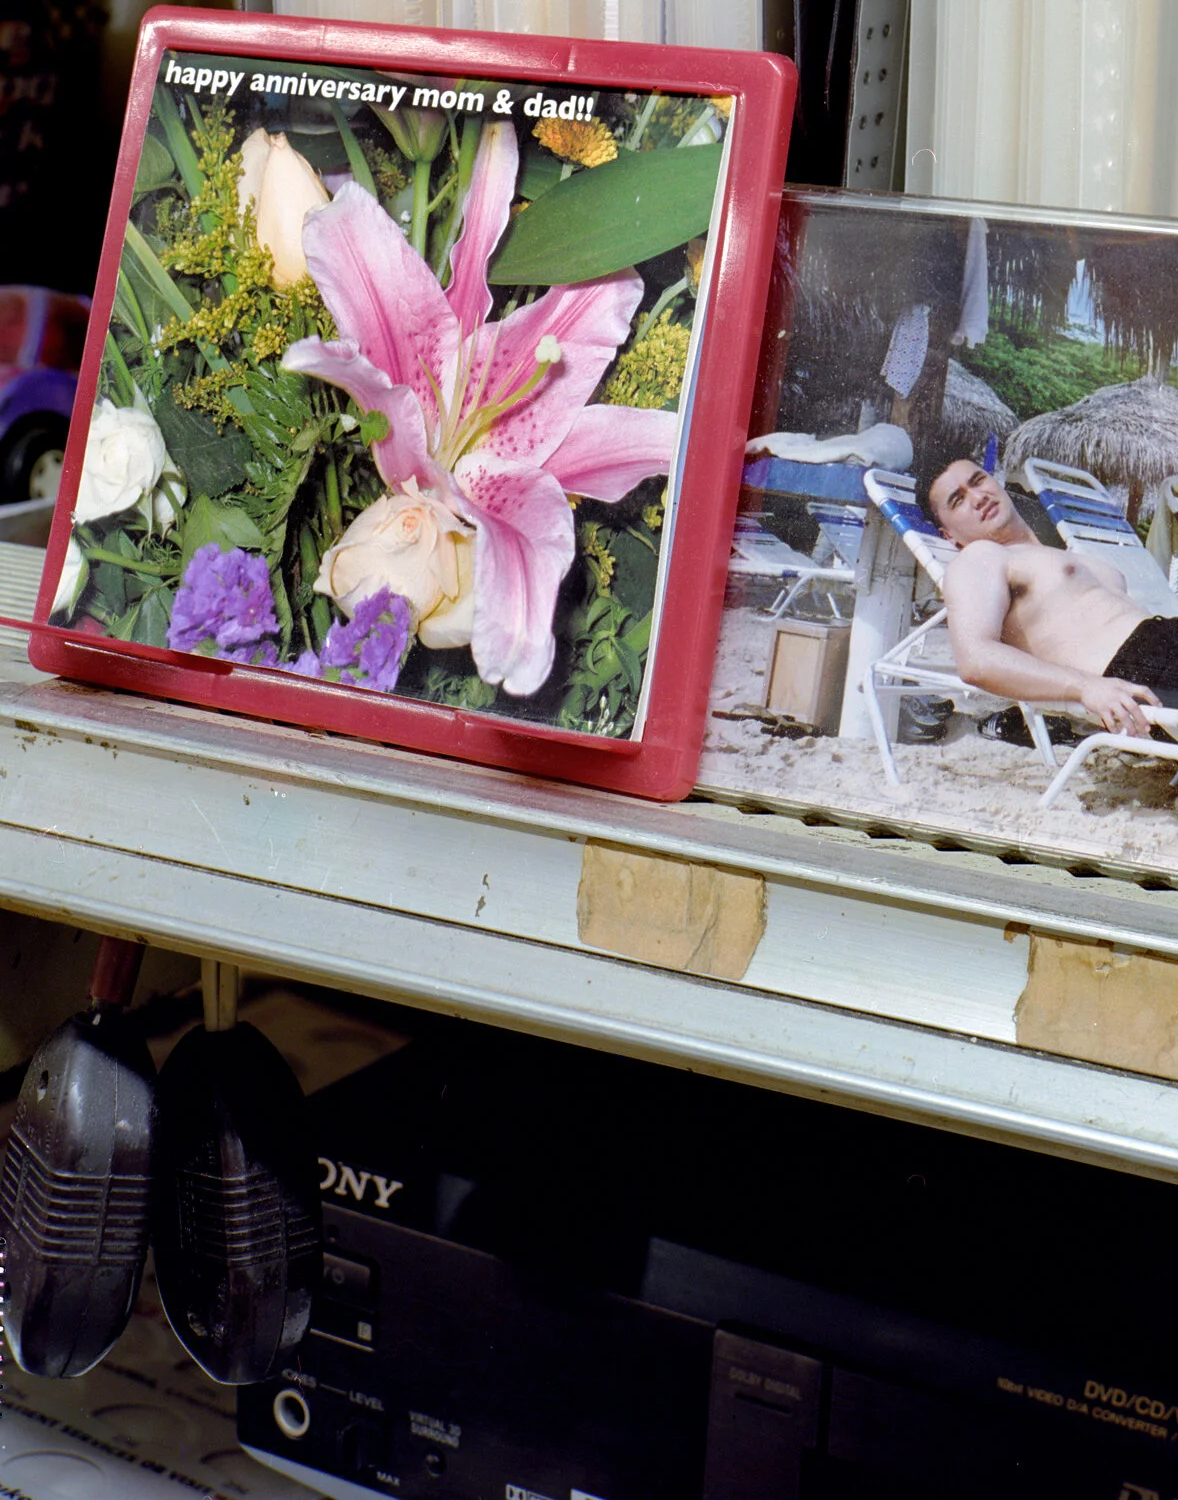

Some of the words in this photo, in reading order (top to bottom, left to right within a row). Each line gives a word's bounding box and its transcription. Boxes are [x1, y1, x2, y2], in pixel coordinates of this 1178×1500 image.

[165, 60, 243, 97] happy
[249, 72, 407, 112] anniversary
[412, 88, 485, 115] mom
[491, 89, 514, 115] &
[522, 91, 596, 122] dad!!
[317, 1155, 405, 1209] ONY
